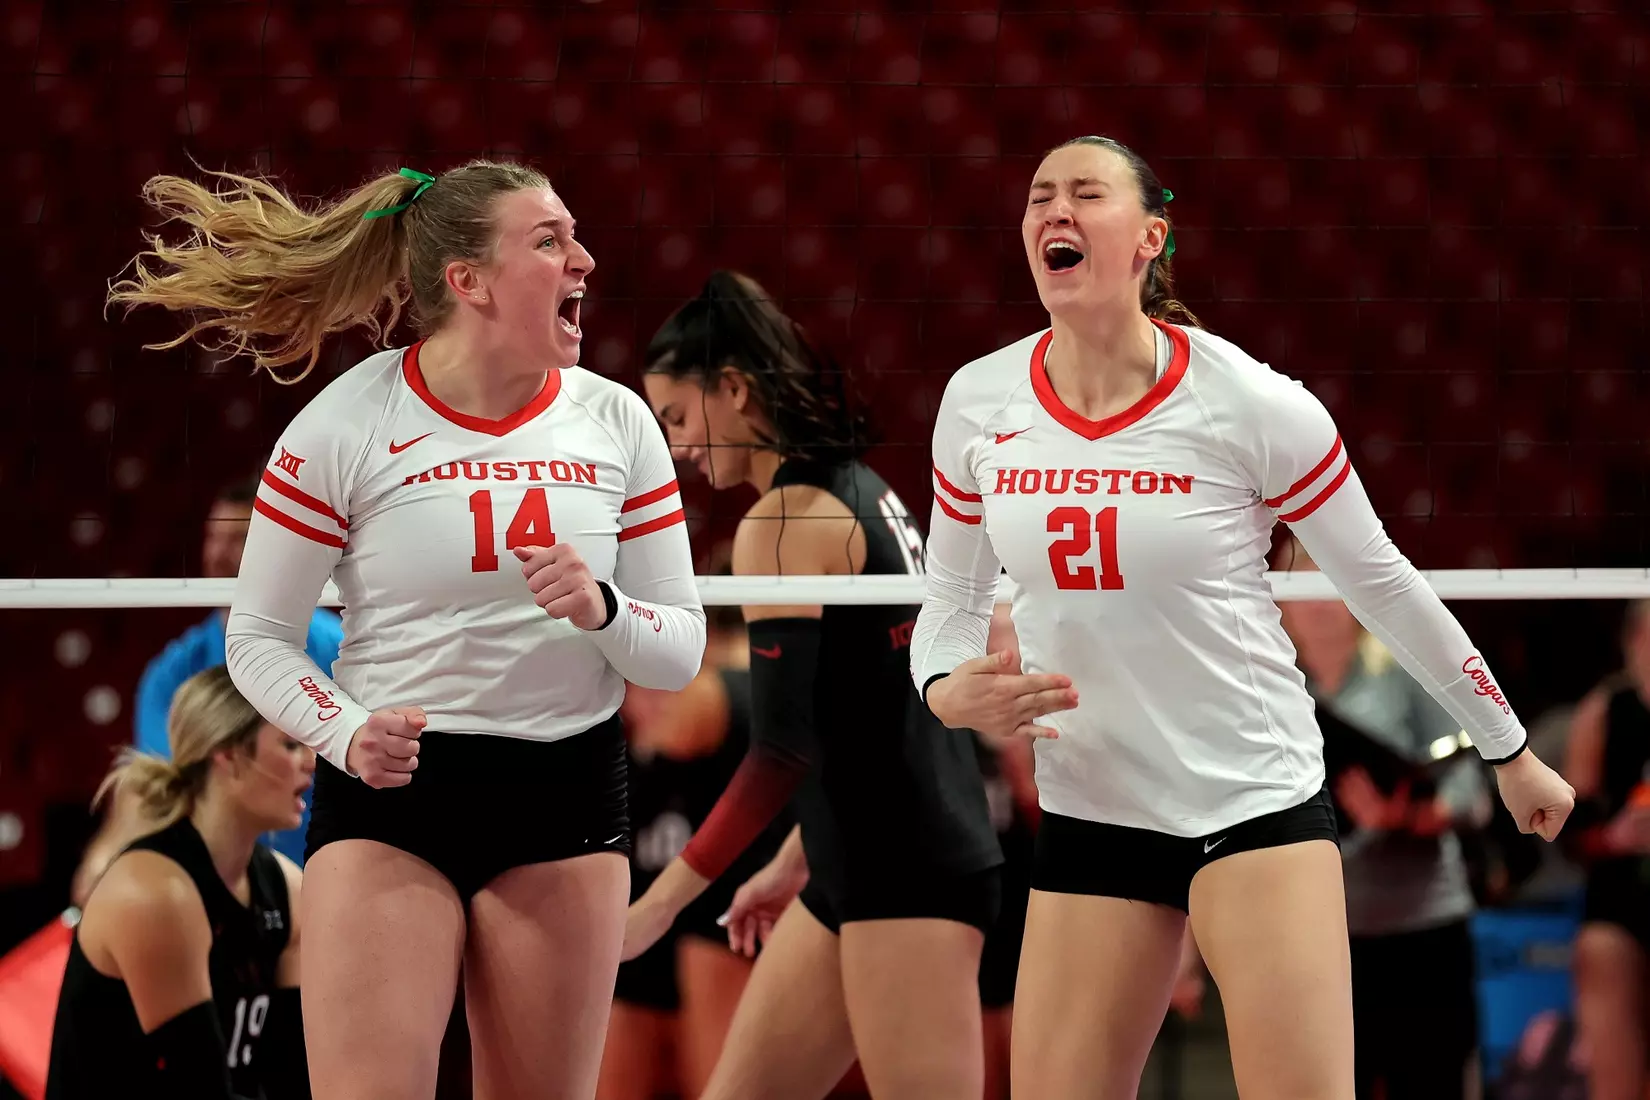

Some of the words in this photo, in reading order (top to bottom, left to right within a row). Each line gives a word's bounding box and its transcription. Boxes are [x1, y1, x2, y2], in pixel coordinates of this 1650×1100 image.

[993, 469, 1195, 494] HOUSTON
[469, 488, 556, 572] 14
[1046, 506, 1125, 590] 21
[1462, 656, 1511, 715] Cougars
[227, 994, 270, 1068] 19
